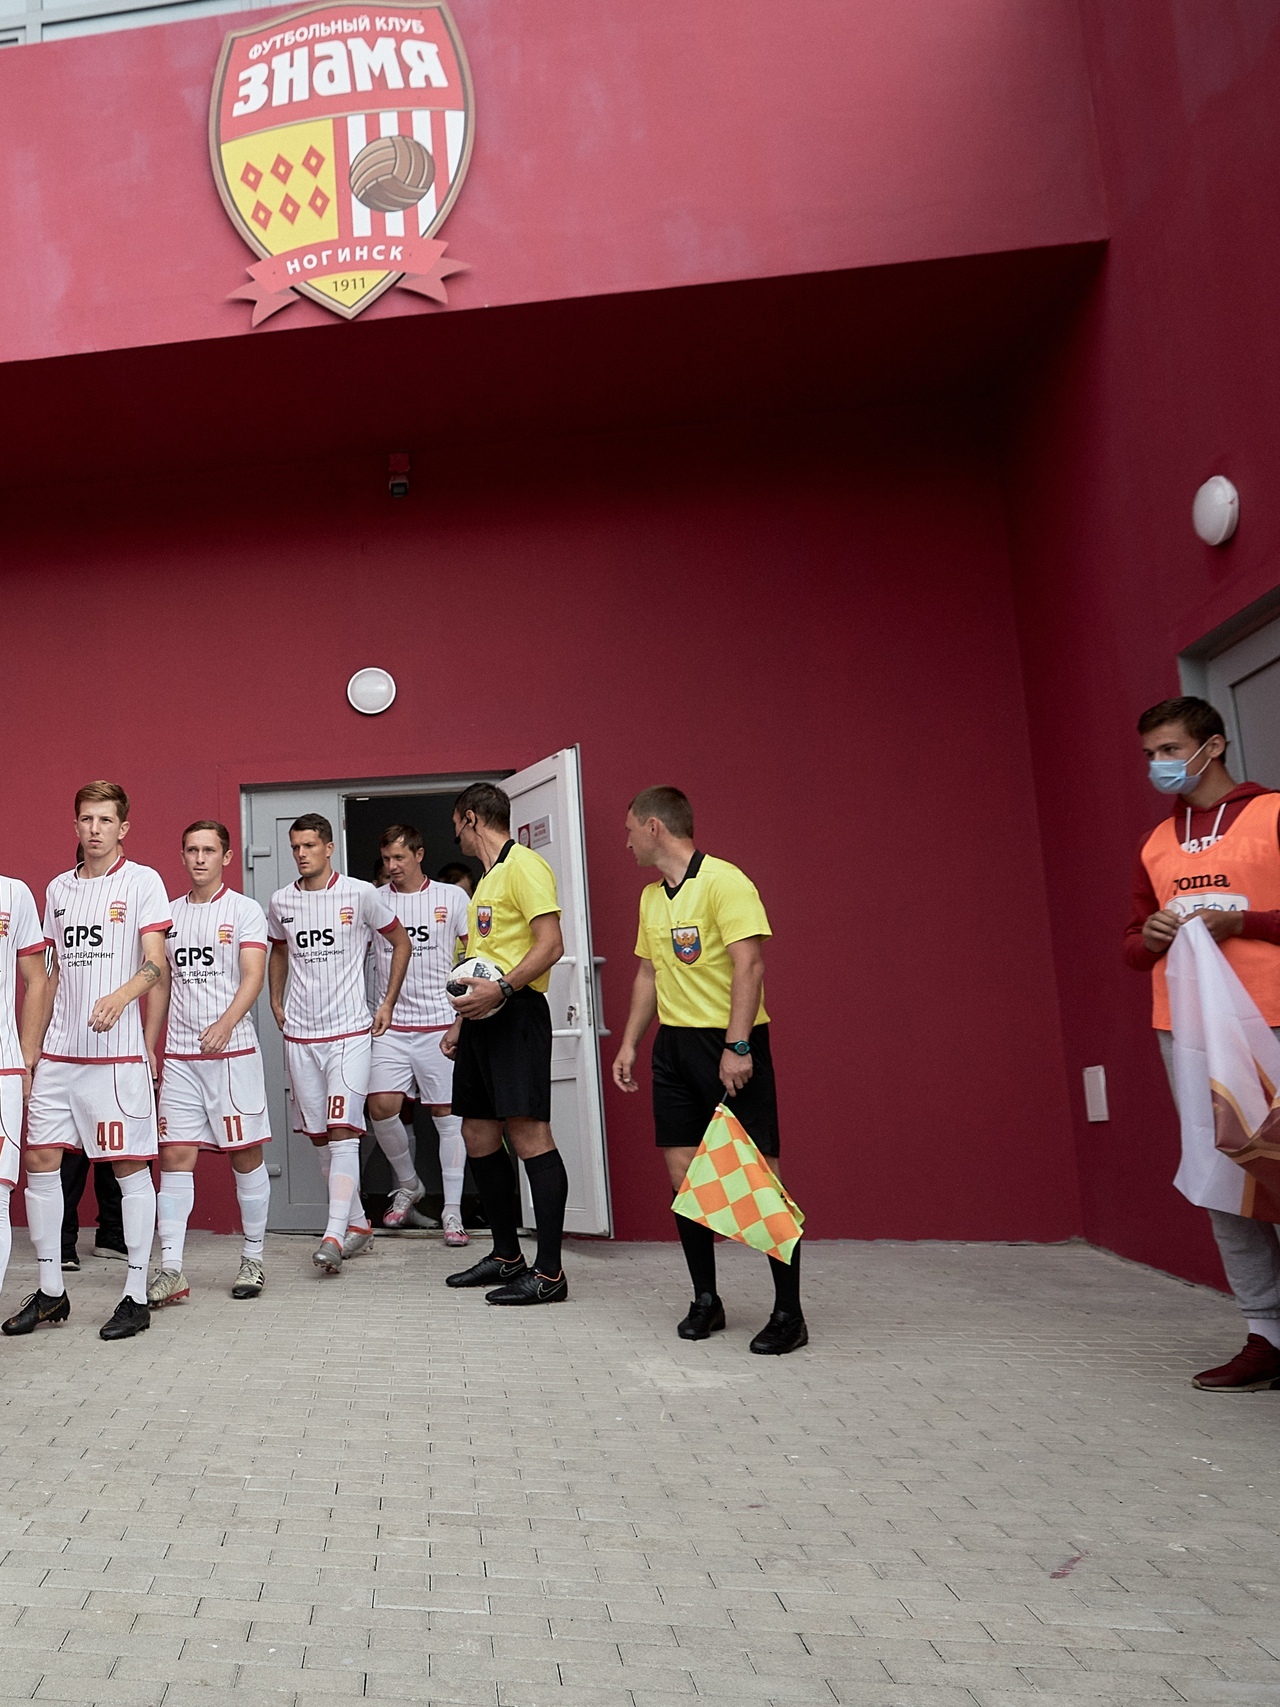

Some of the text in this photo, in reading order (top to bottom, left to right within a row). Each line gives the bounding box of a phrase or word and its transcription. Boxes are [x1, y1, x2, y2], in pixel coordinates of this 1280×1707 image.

[248, 14, 425, 60] ФУТБОЛЬНЫЙ КЛУБ
[286, 245, 403, 275] НОГИНСК
[332, 277, 366, 292] 1911
[64, 925, 103, 948] GPS
[295, 928, 335, 949] GPS
[404, 925, 429, 942] PS
[174, 946, 214, 967] GPS
[97, 1121, 124, 1151] 40
[223, 1115, 244, 1142] 11
